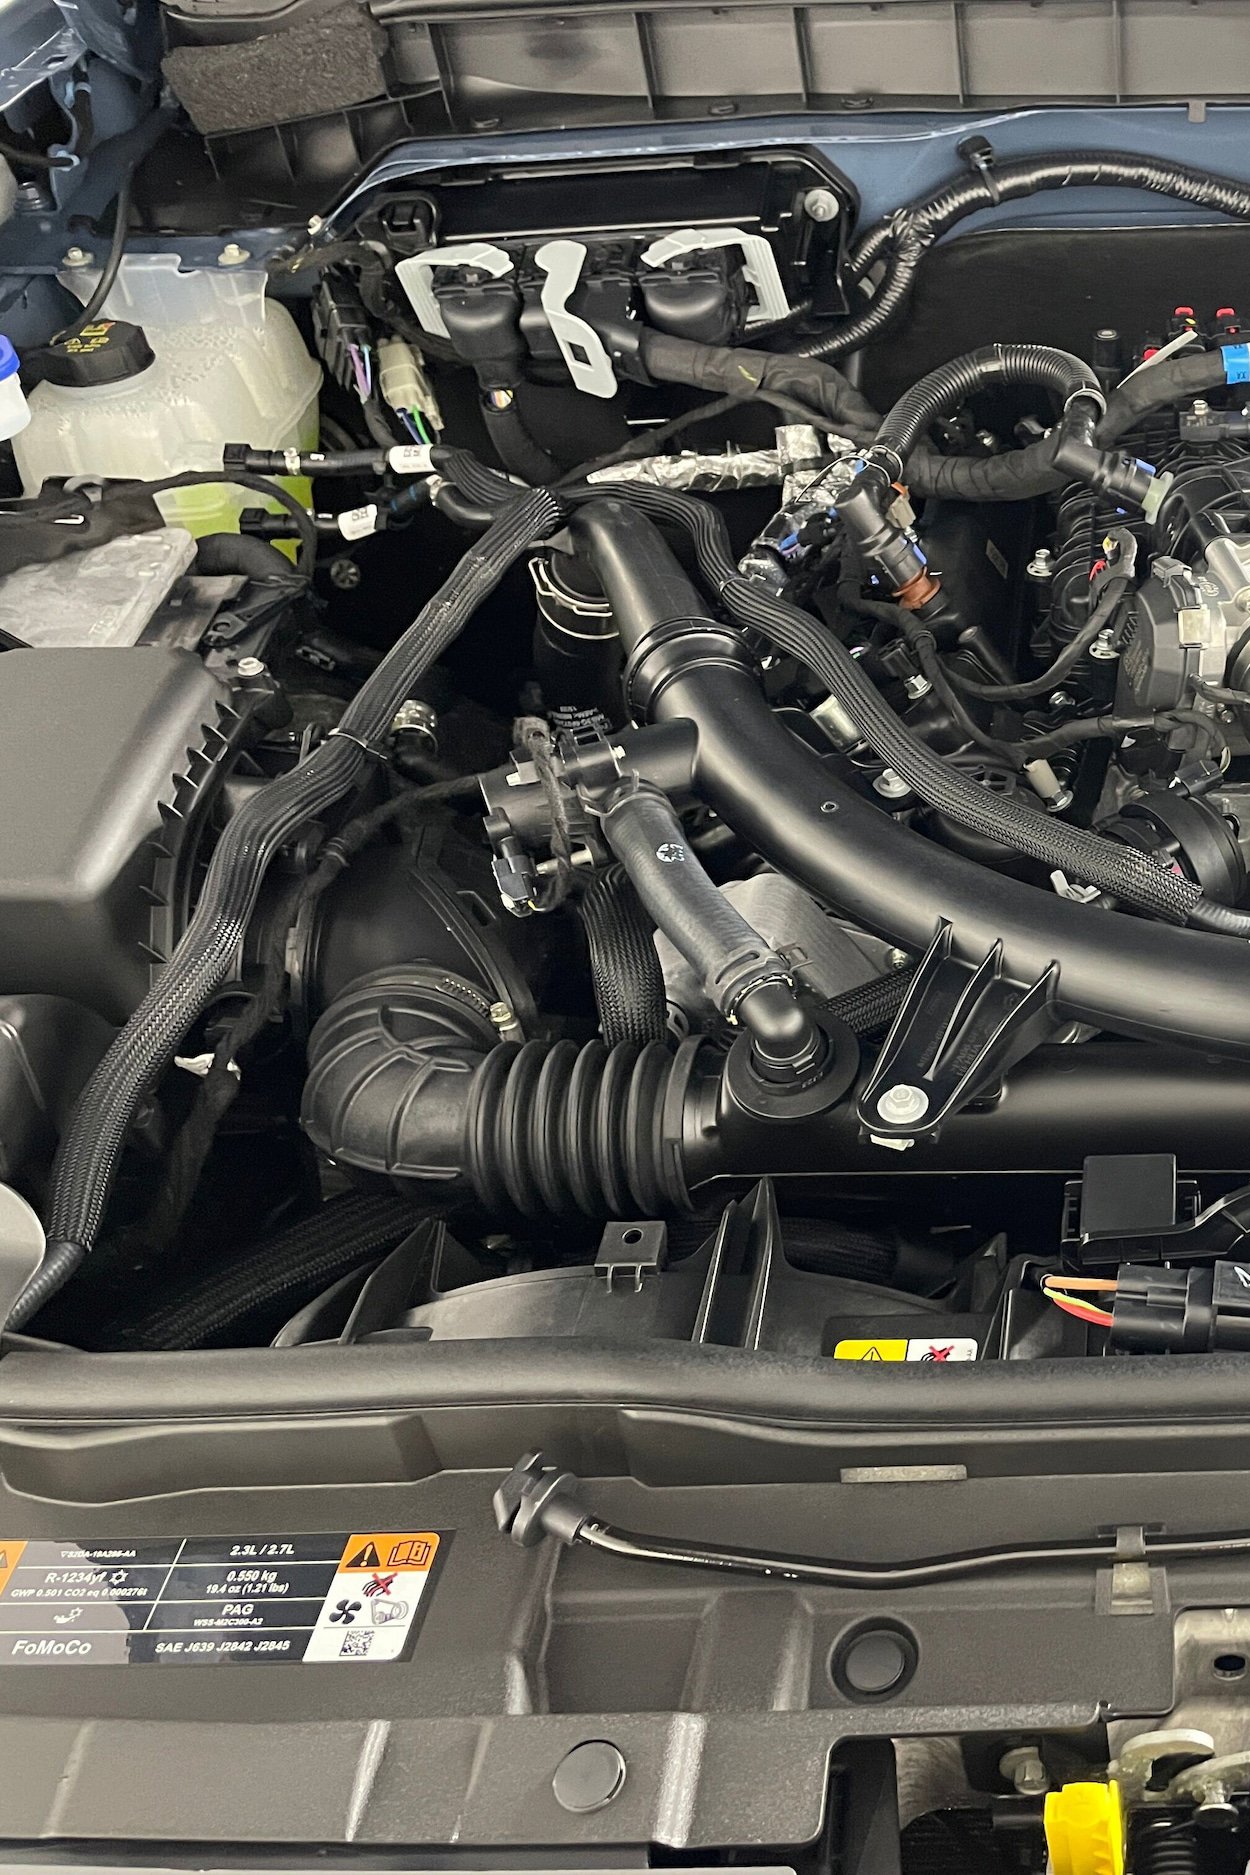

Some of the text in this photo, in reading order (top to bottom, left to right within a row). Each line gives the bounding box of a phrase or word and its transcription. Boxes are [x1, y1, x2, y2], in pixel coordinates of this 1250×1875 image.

[229, 1543, 295, 1556] 2.3L / 2.7L
[44, 1571, 108, 1585] R-1234yf
[226, 1569, 278, 1583] 0.550 kg
[11, 1588, 36, 1597] GWP
[36, 1588, 62, 1597] 0.501
[64, 1588, 86, 1597] CO2
[86, 1589, 99, 1598] eq
[206, 1583, 228, 1594] 19.4
[241, 1582, 267, 1595] (1.21
[268, 1582, 290, 1595] lbs)
[221, 1603, 255, 1616] PAG
[11, 1639, 92, 1656] FoMoCo
[155, 1640, 291, 1654] SAE J639 J2842 J2845
